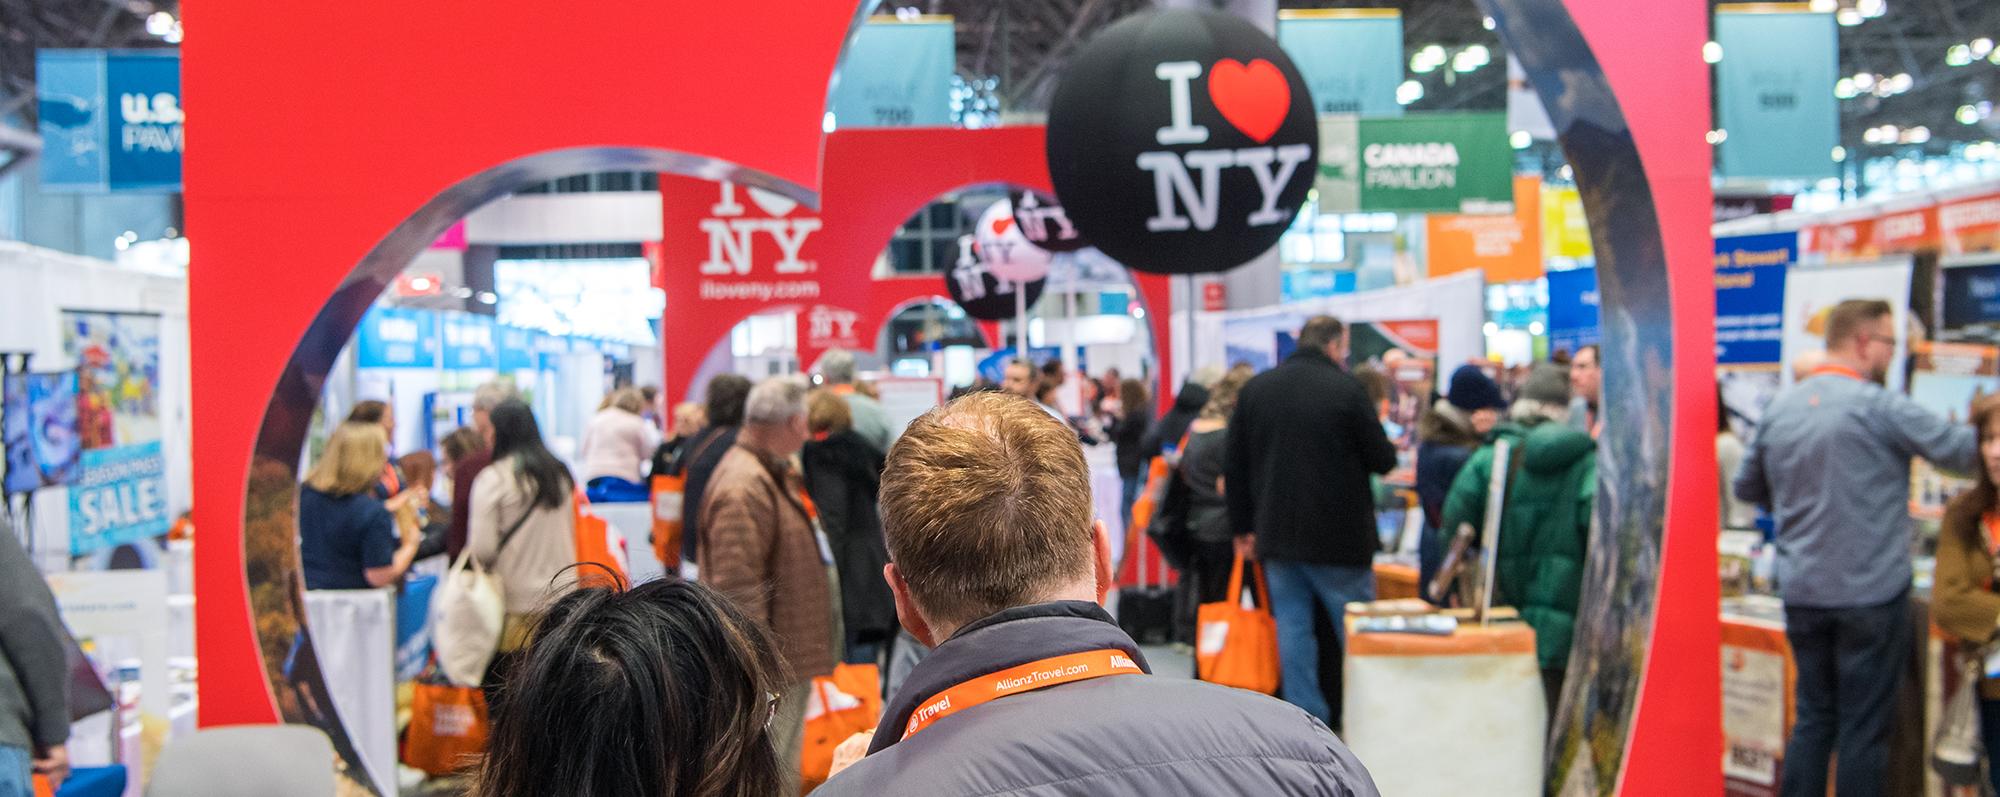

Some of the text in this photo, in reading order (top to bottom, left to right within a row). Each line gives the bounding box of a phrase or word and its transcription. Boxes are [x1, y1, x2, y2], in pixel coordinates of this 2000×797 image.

[1156, 60, 1209, 145] I
[1364, 142, 1460, 169] CANADA
[1136, 144, 1311, 231] NY
[1365, 168, 1457, 190] PAVILION
[700, 280, 821, 302] iloveny.com
[81, 480, 163, 535] SALE
[996, 664, 1089, 691] AllianzTravel.com
[918, 695, 951, 722] Travel
